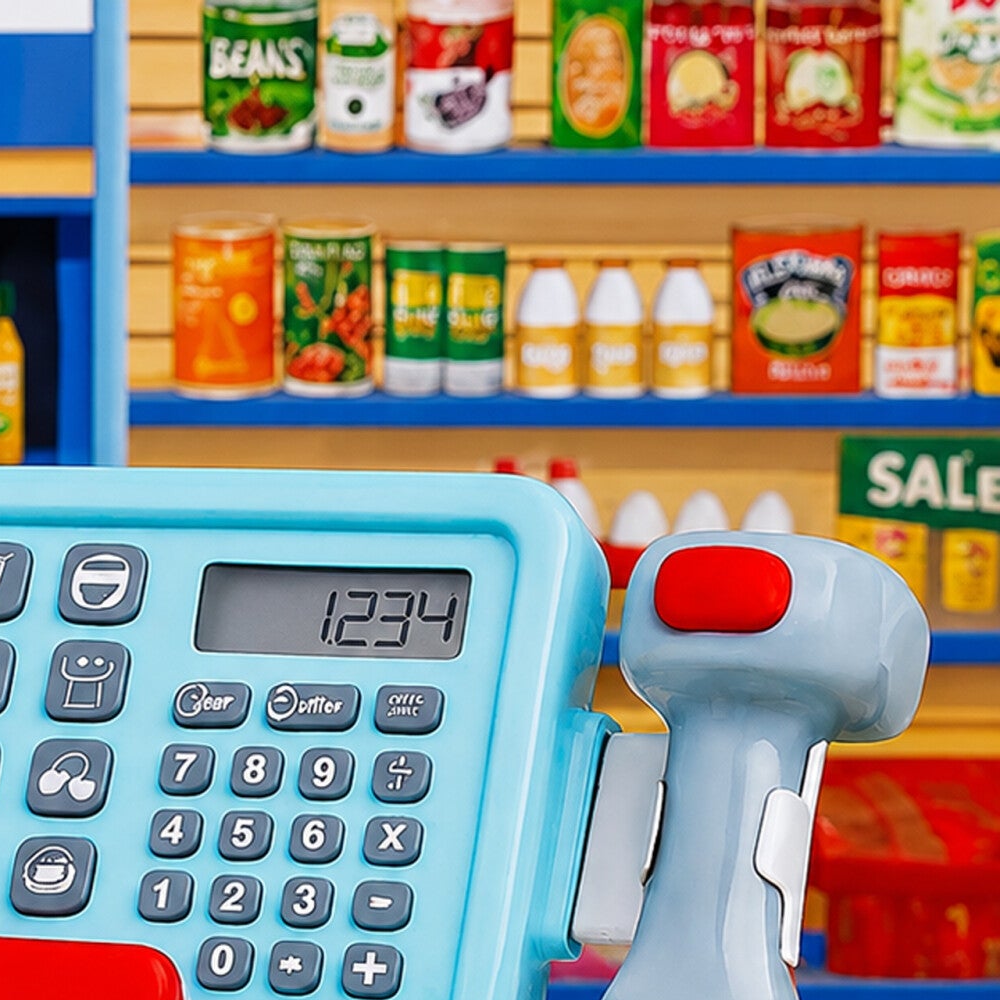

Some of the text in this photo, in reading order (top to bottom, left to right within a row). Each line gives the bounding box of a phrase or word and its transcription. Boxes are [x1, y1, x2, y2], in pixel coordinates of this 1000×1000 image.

[208, 36, 314, 82] BEANS
[866, 449, 1000, 515] SALE
[175, 752, 197, 782] 7
[243, 754, 266, 784] 8
[312, 756, 335, 787] 9
[160, 815, 184, 845] 4
[231, 818, 254, 848] 5
[302, 820, 325, 850] 6
[153, 878, 170, 909] 1
[219, 881, 245, 912] 2
[292, 884, 316, 915] 3
[210, 944, 234, 976] 0
